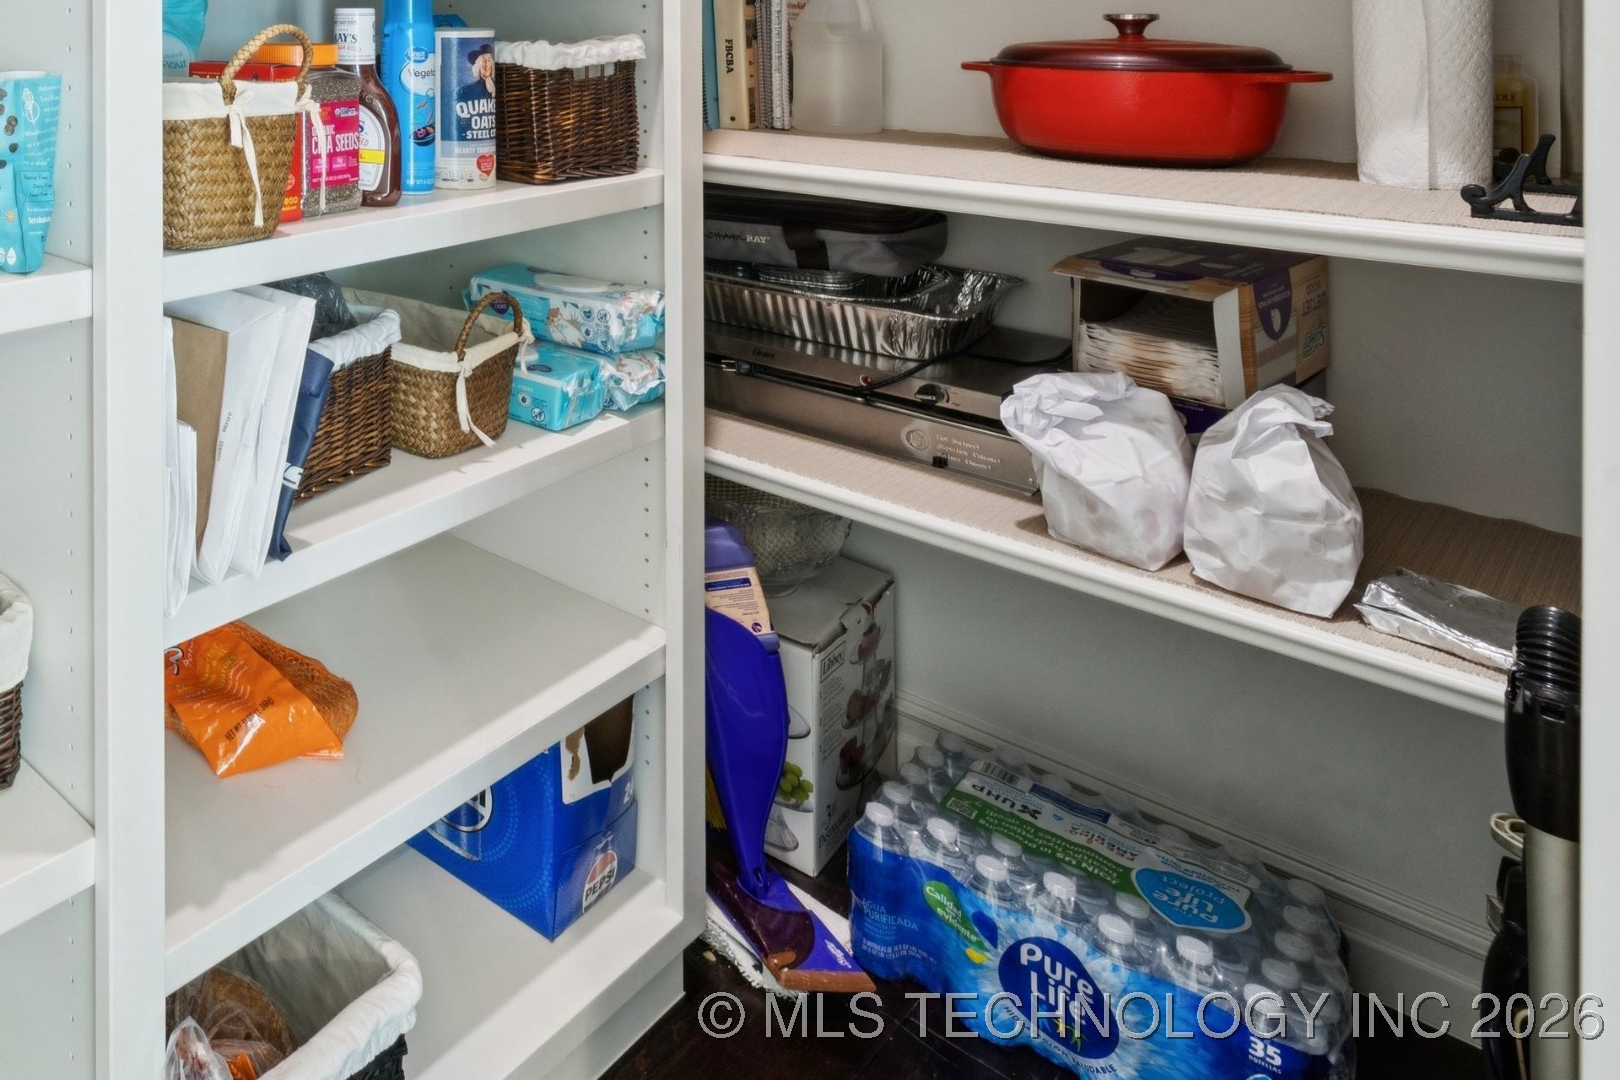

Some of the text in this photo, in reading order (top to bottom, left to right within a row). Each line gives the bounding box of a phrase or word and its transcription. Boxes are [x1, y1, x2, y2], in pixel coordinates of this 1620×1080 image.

[724, 39, 735, 75] FBCBA
[466, 129, 489, 140] STEEL
[471, 115, 497, 131] OATS
[335, 132, 359, 150] SEEDS
[746, 234, 767, 244] RAY
[822, 651, 844, 676] Libbey
[585, 866, 616, 902] PEPSI
[862, 897, 886, 914] AGUA
[925, 886, 962, 918] Calidad
[1153, 890, 1219, 924] Pure
[1163, 886, 1215, 912] Life
[863, 907, 919, 932] PURIFICADA
[936, 905, 980, 943] evidente
[1020, 942, 1095, 1005] Pure
[1030, 970, 1088, 1026] Life
[1248, 1036, 1282, 1066] 35
